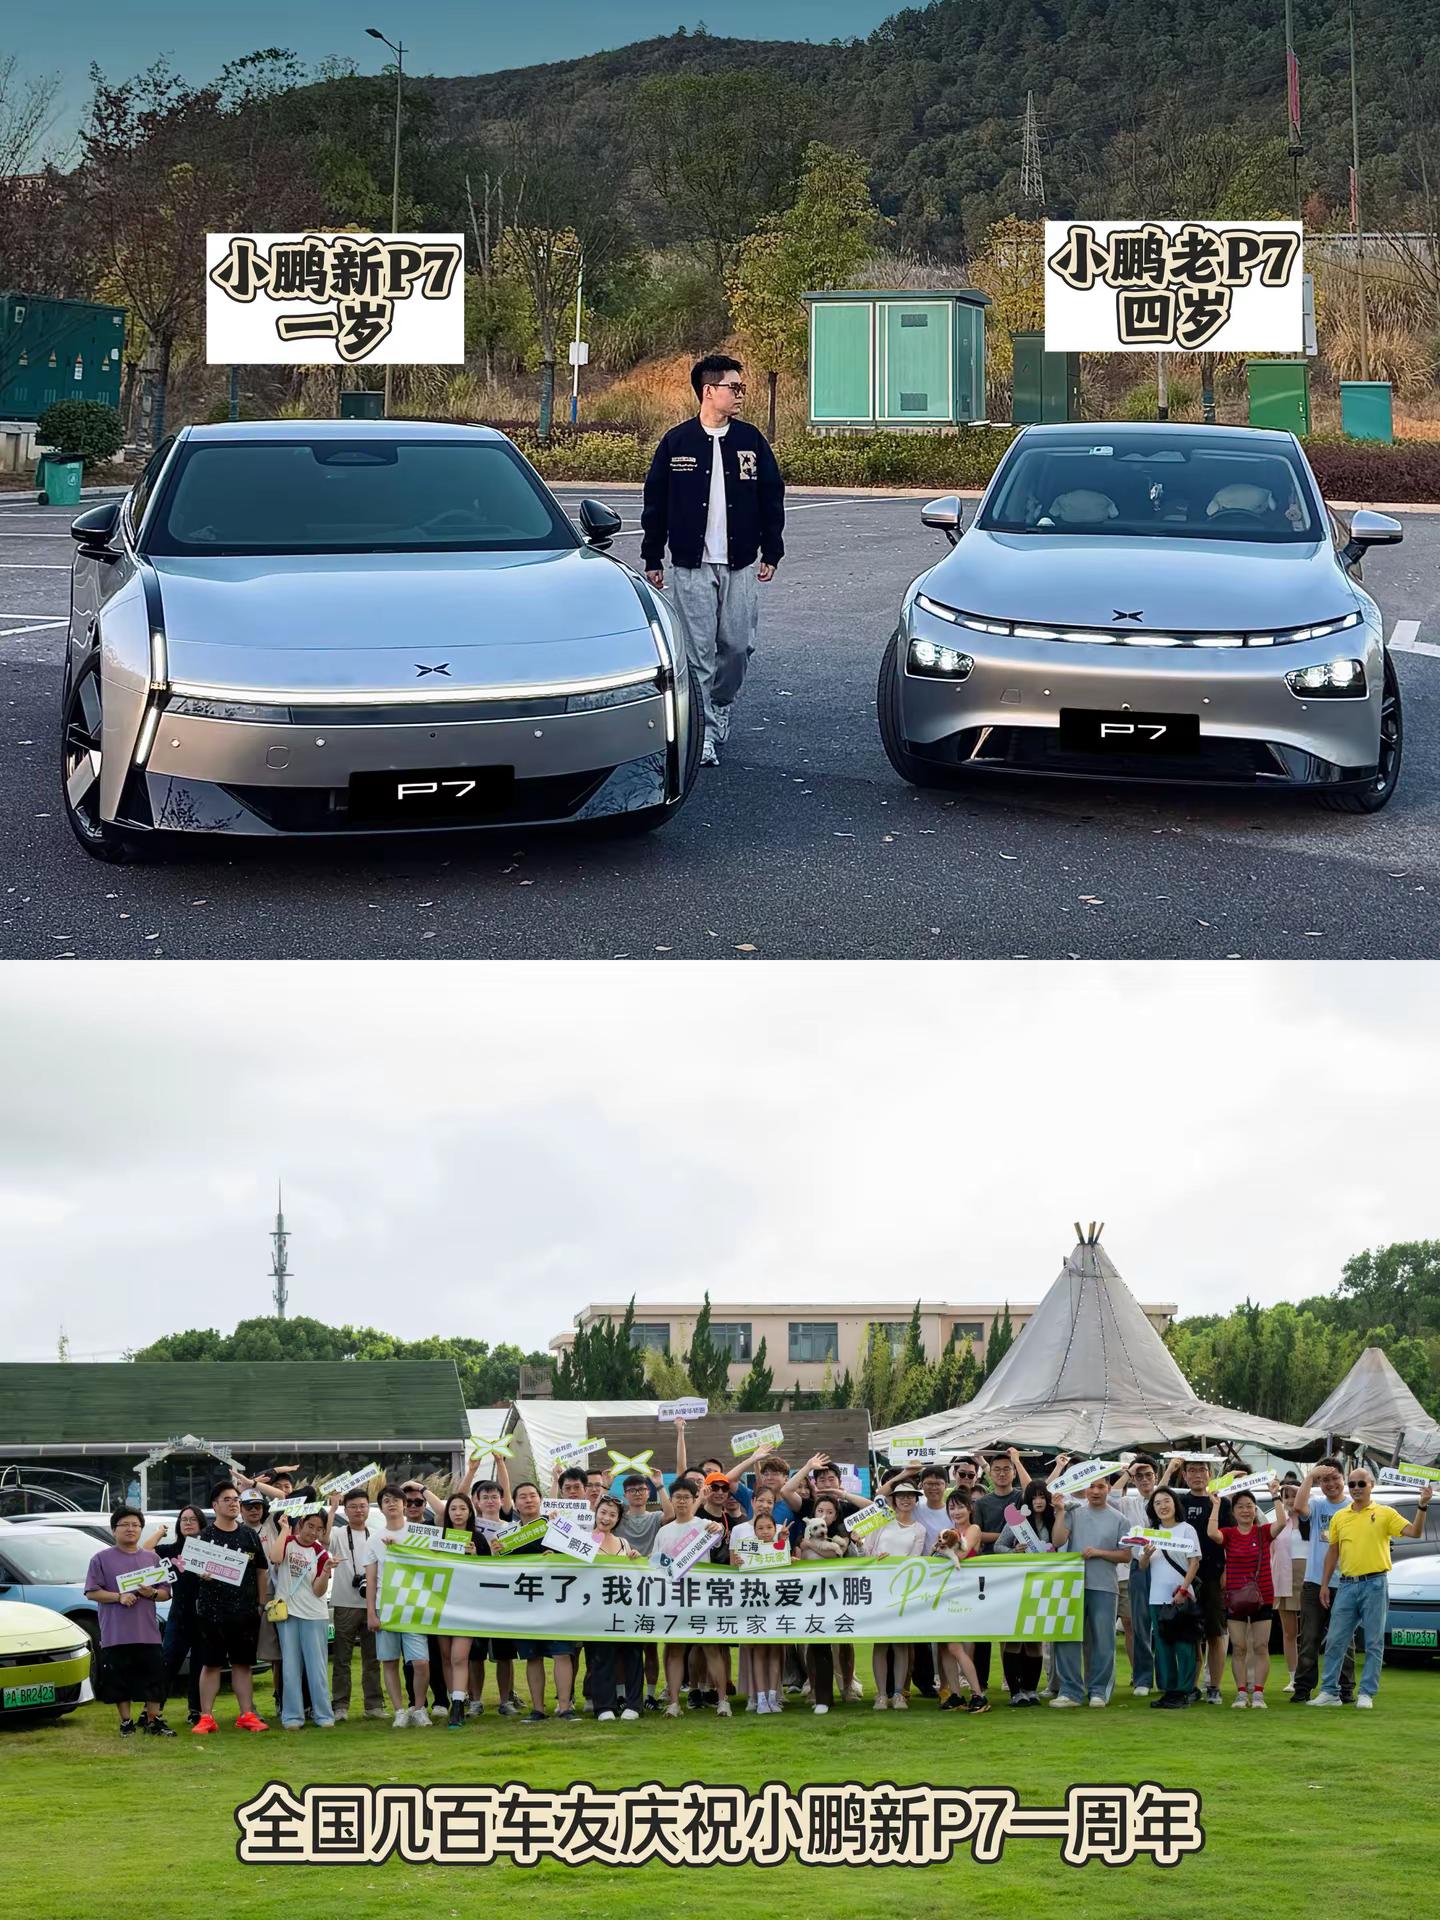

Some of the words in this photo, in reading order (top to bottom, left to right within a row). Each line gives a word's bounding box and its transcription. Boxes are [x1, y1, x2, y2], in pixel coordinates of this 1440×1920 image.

[1101, 723, 1167, 740] P7
[398, 780, 476, 800] P7
[907, 1448, 937, 1457] P7超车
[1382, 1471, 1426, 1485] 人生事事没烦恼
[551, 1517, 573, 1534] 上海
[738, 1541, 759, 1552] 上海
[747, 1552, 786, 1566] 7号玩家
[121, 1570, 165, 1591] P7
[604, 1613, 856, 1635] 上海7号玩家车友会
